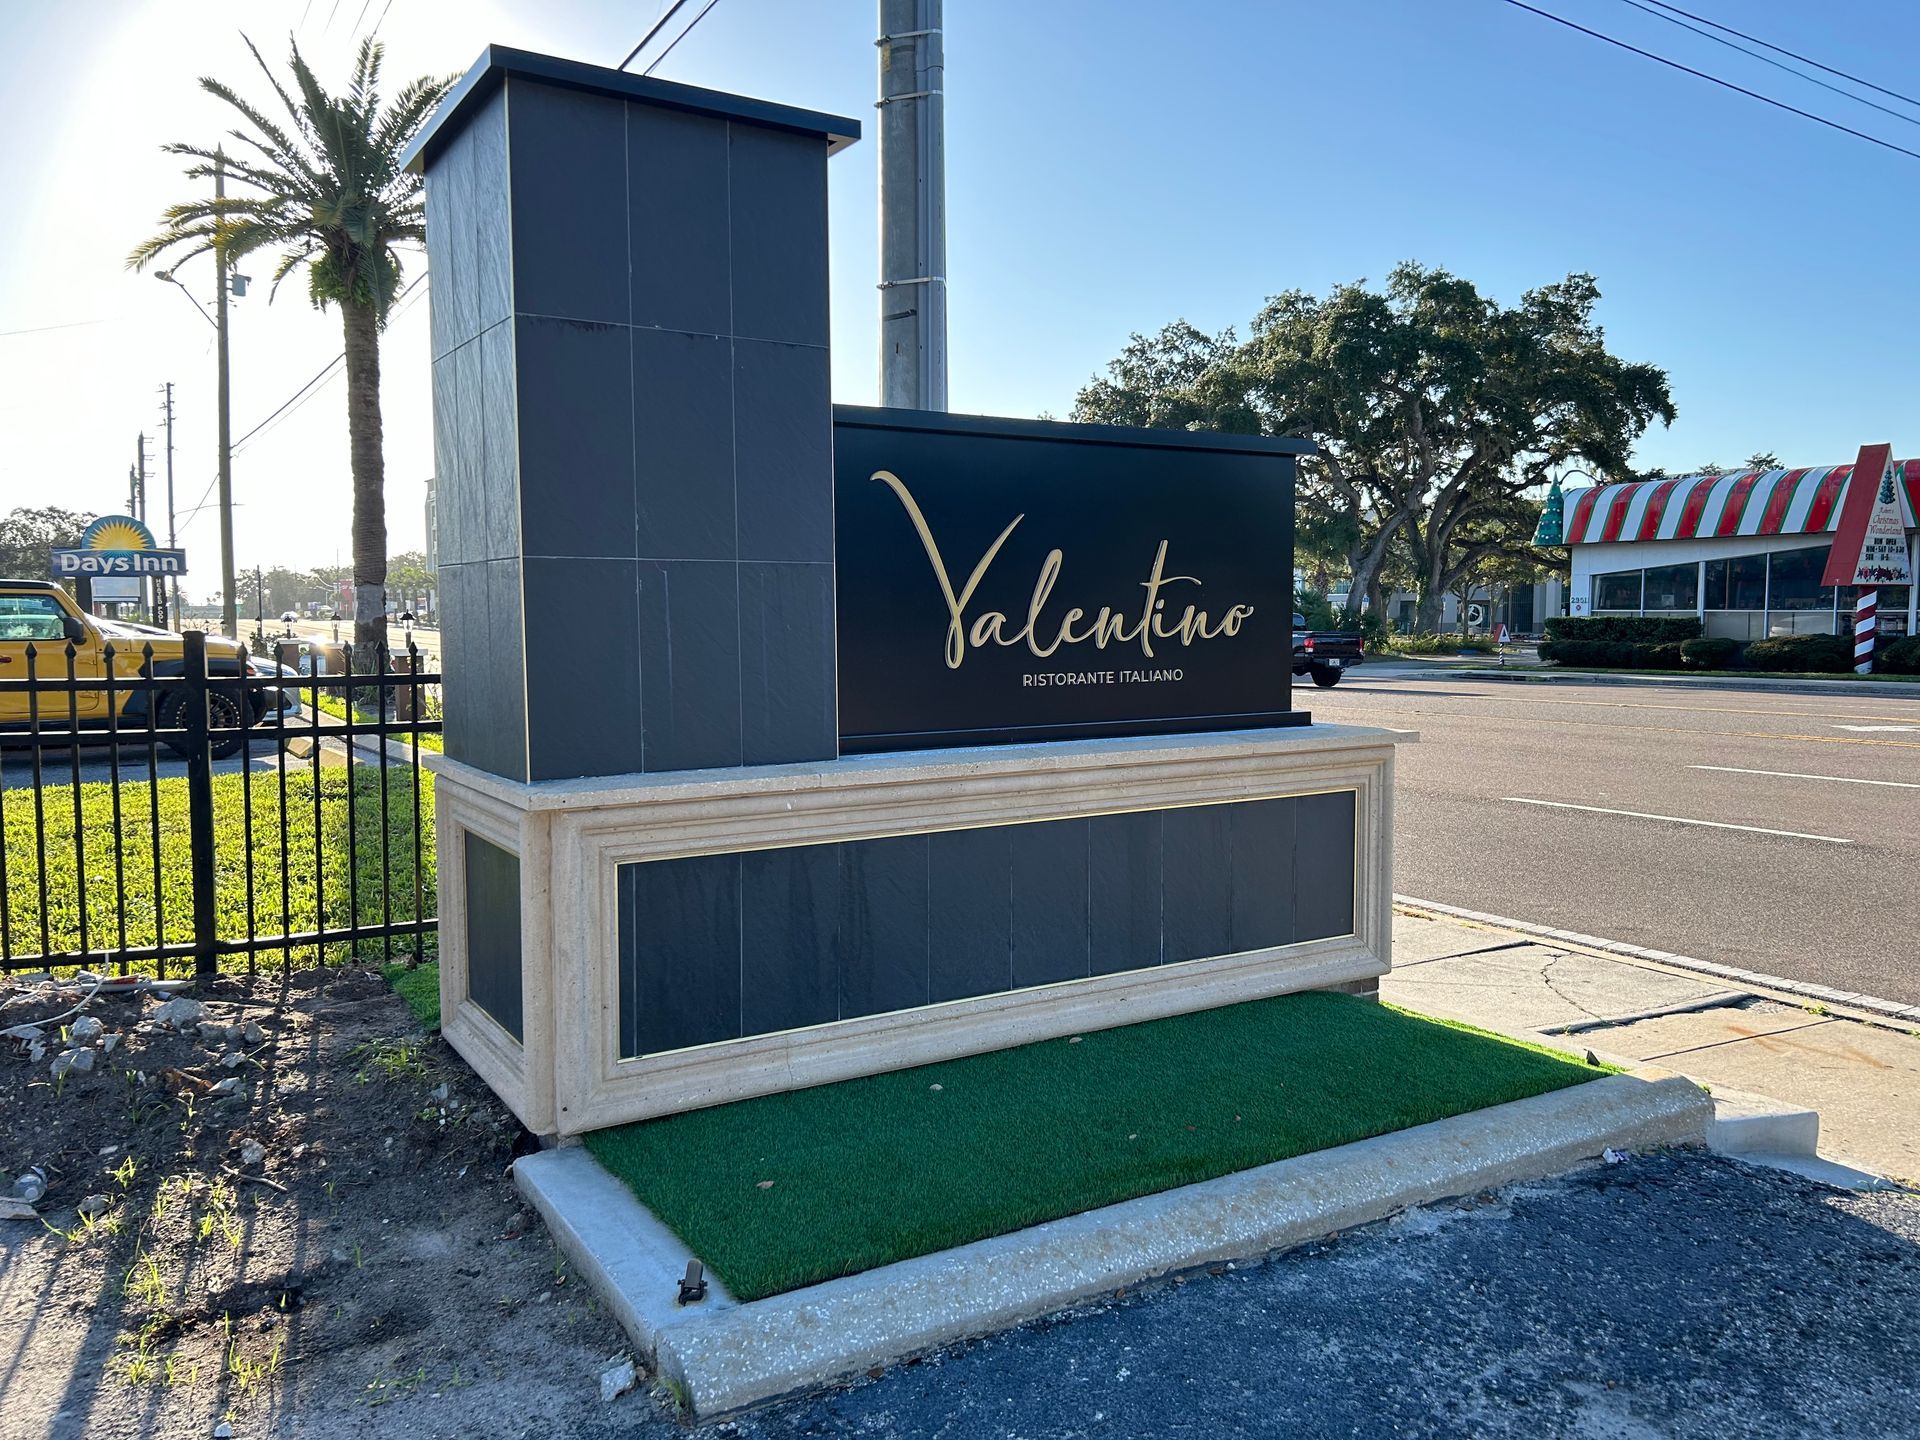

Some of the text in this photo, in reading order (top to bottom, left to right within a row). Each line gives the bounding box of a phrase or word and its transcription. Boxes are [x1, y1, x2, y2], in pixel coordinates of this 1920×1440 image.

[60, 553, 178, 574] Days Inn
[869, 470, 1255, 669] Valentino
[1022, 668, 1184, 687] RISTORANTE ITALIANO
